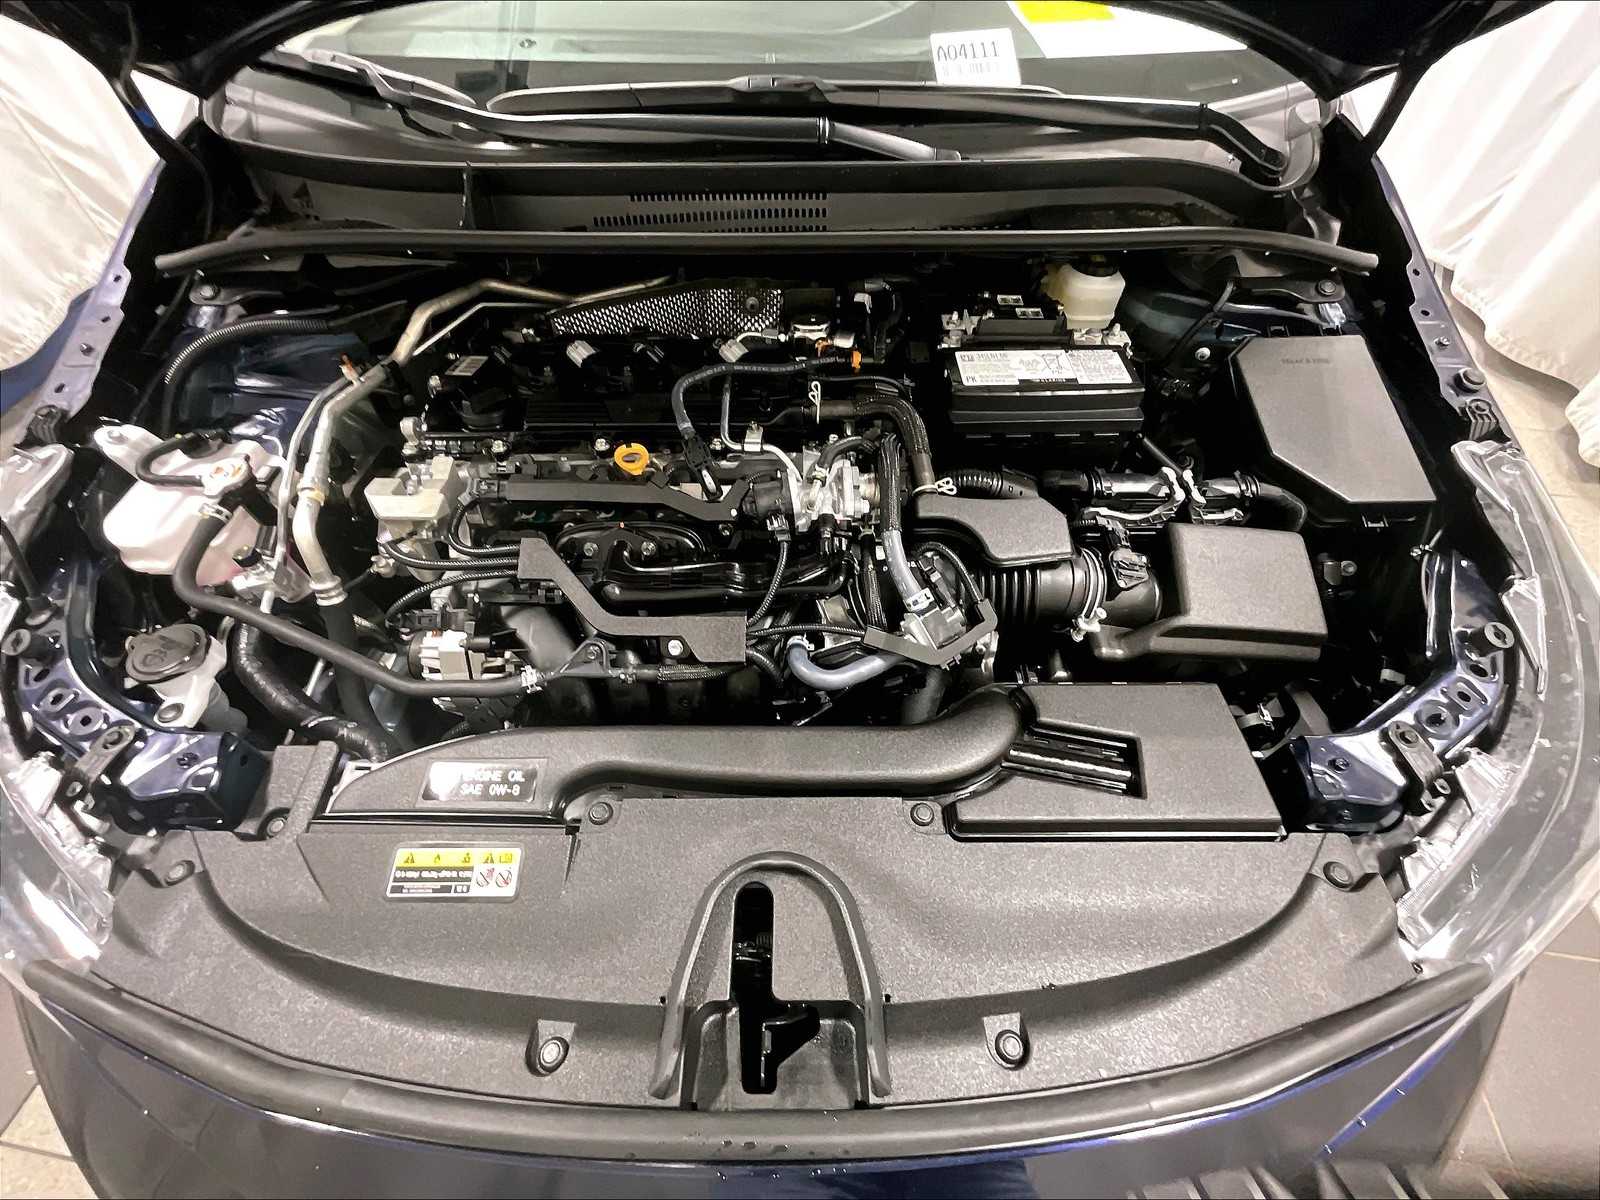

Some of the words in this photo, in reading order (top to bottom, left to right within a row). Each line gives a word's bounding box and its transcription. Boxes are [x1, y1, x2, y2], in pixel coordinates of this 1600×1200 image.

[937, 41, 999, 61] A04111
[461, 769, 503, 782] GINE
[507, 770, 526, 783] OIL
[459, 783, 484, 796] SAE
[488, 783, 521, 797] 0W-8
